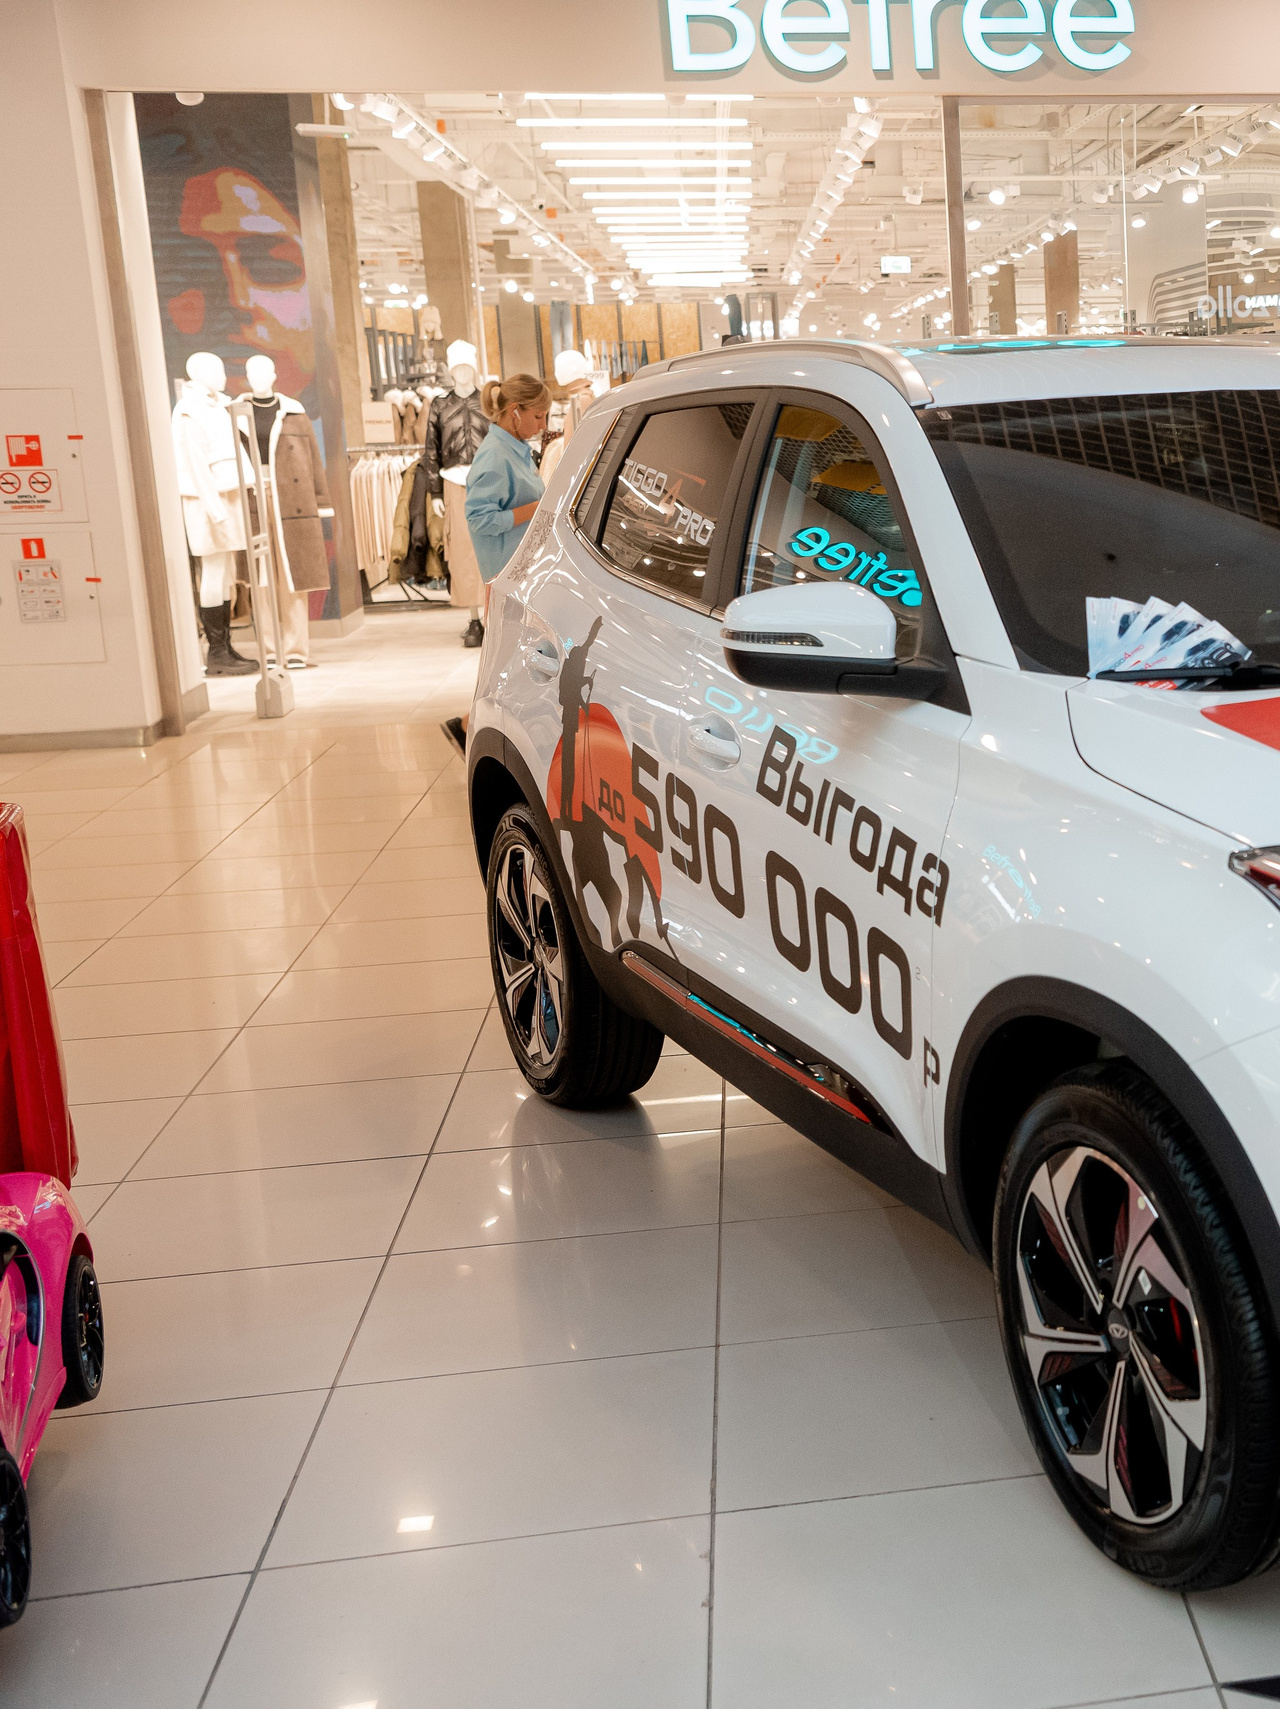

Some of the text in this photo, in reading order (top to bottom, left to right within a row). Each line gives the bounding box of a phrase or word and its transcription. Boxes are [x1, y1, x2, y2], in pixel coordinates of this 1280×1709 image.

[625, 458, 667, 497] TIGGO
[674, 507, 715, 546] PRO
[598, 777, 626, 824] до
[632, 741, 745, 919] 590
[765, 850, 913, 1061] 000
[756, 724, 950, 928] Выгода
